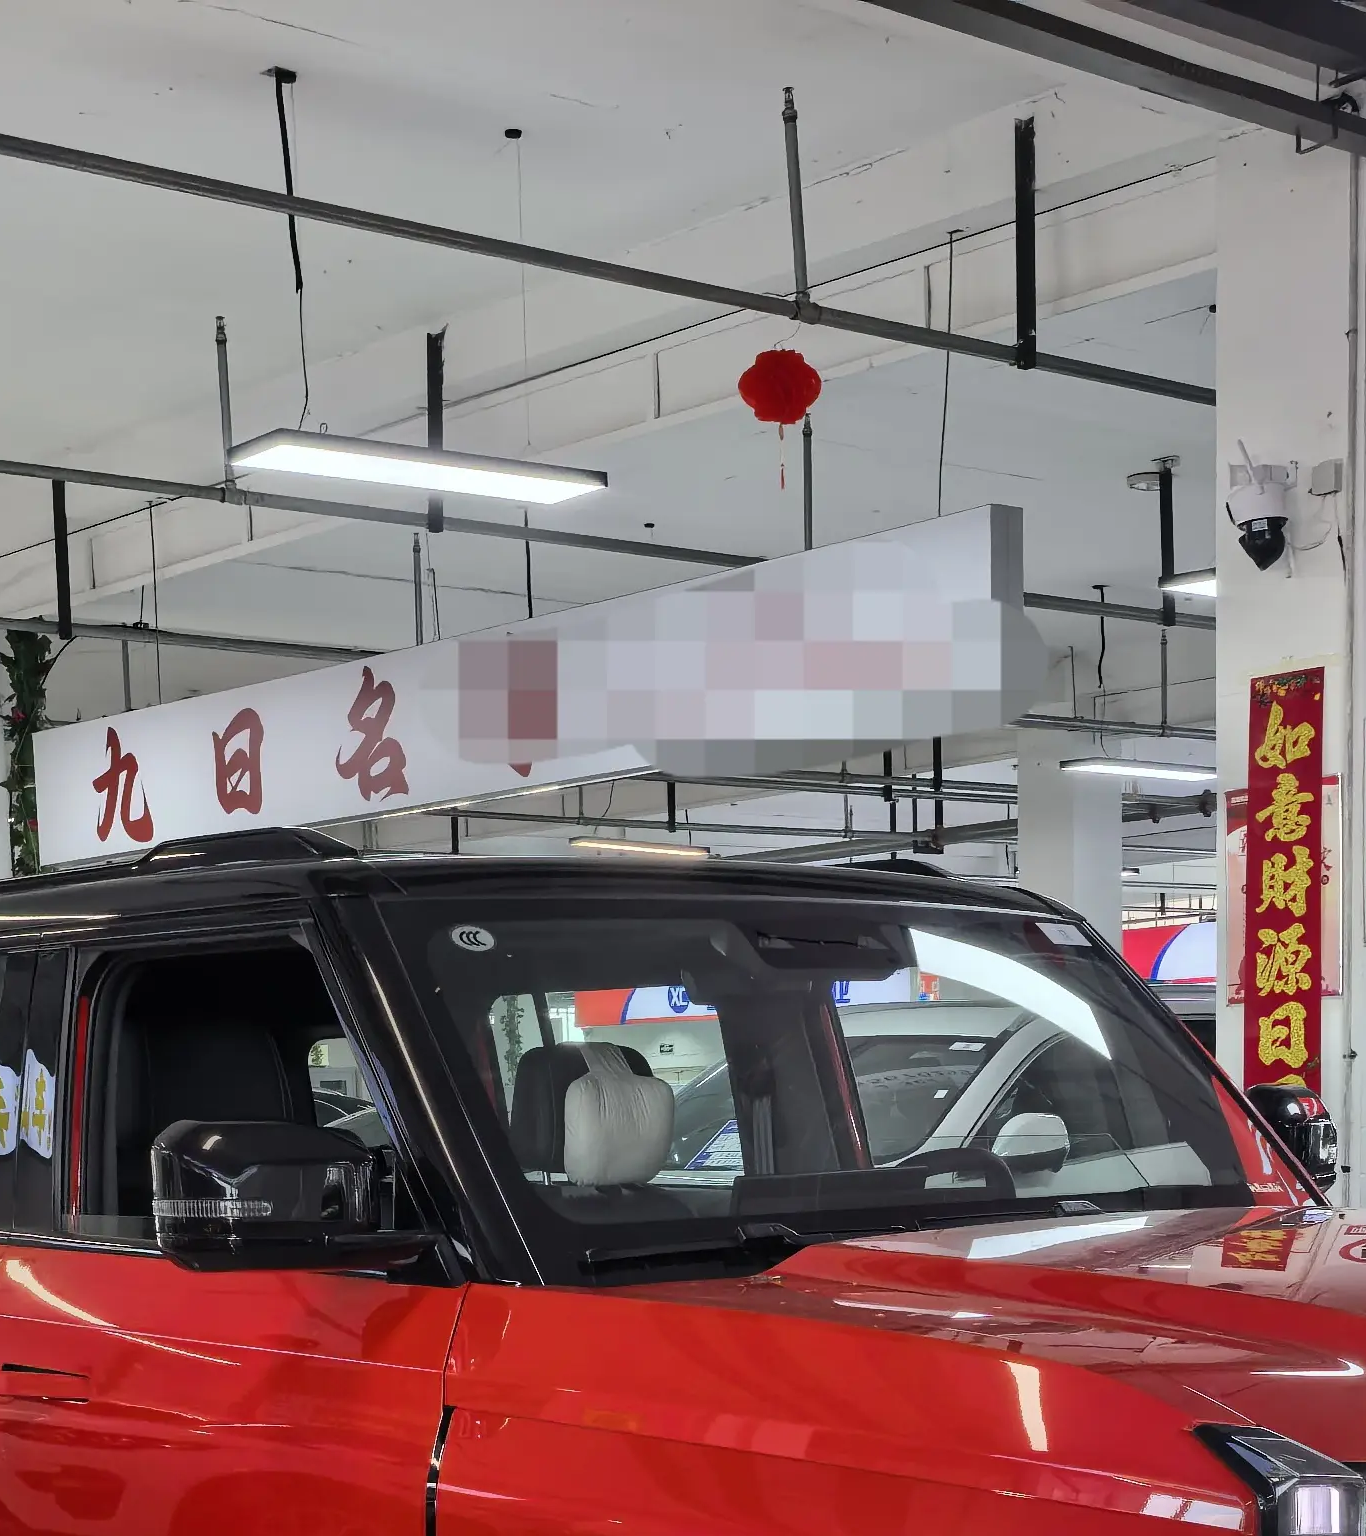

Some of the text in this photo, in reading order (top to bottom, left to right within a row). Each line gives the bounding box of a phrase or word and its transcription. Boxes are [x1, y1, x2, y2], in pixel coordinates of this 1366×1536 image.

[1255, 701, 1316, 1086] 如意財源日
